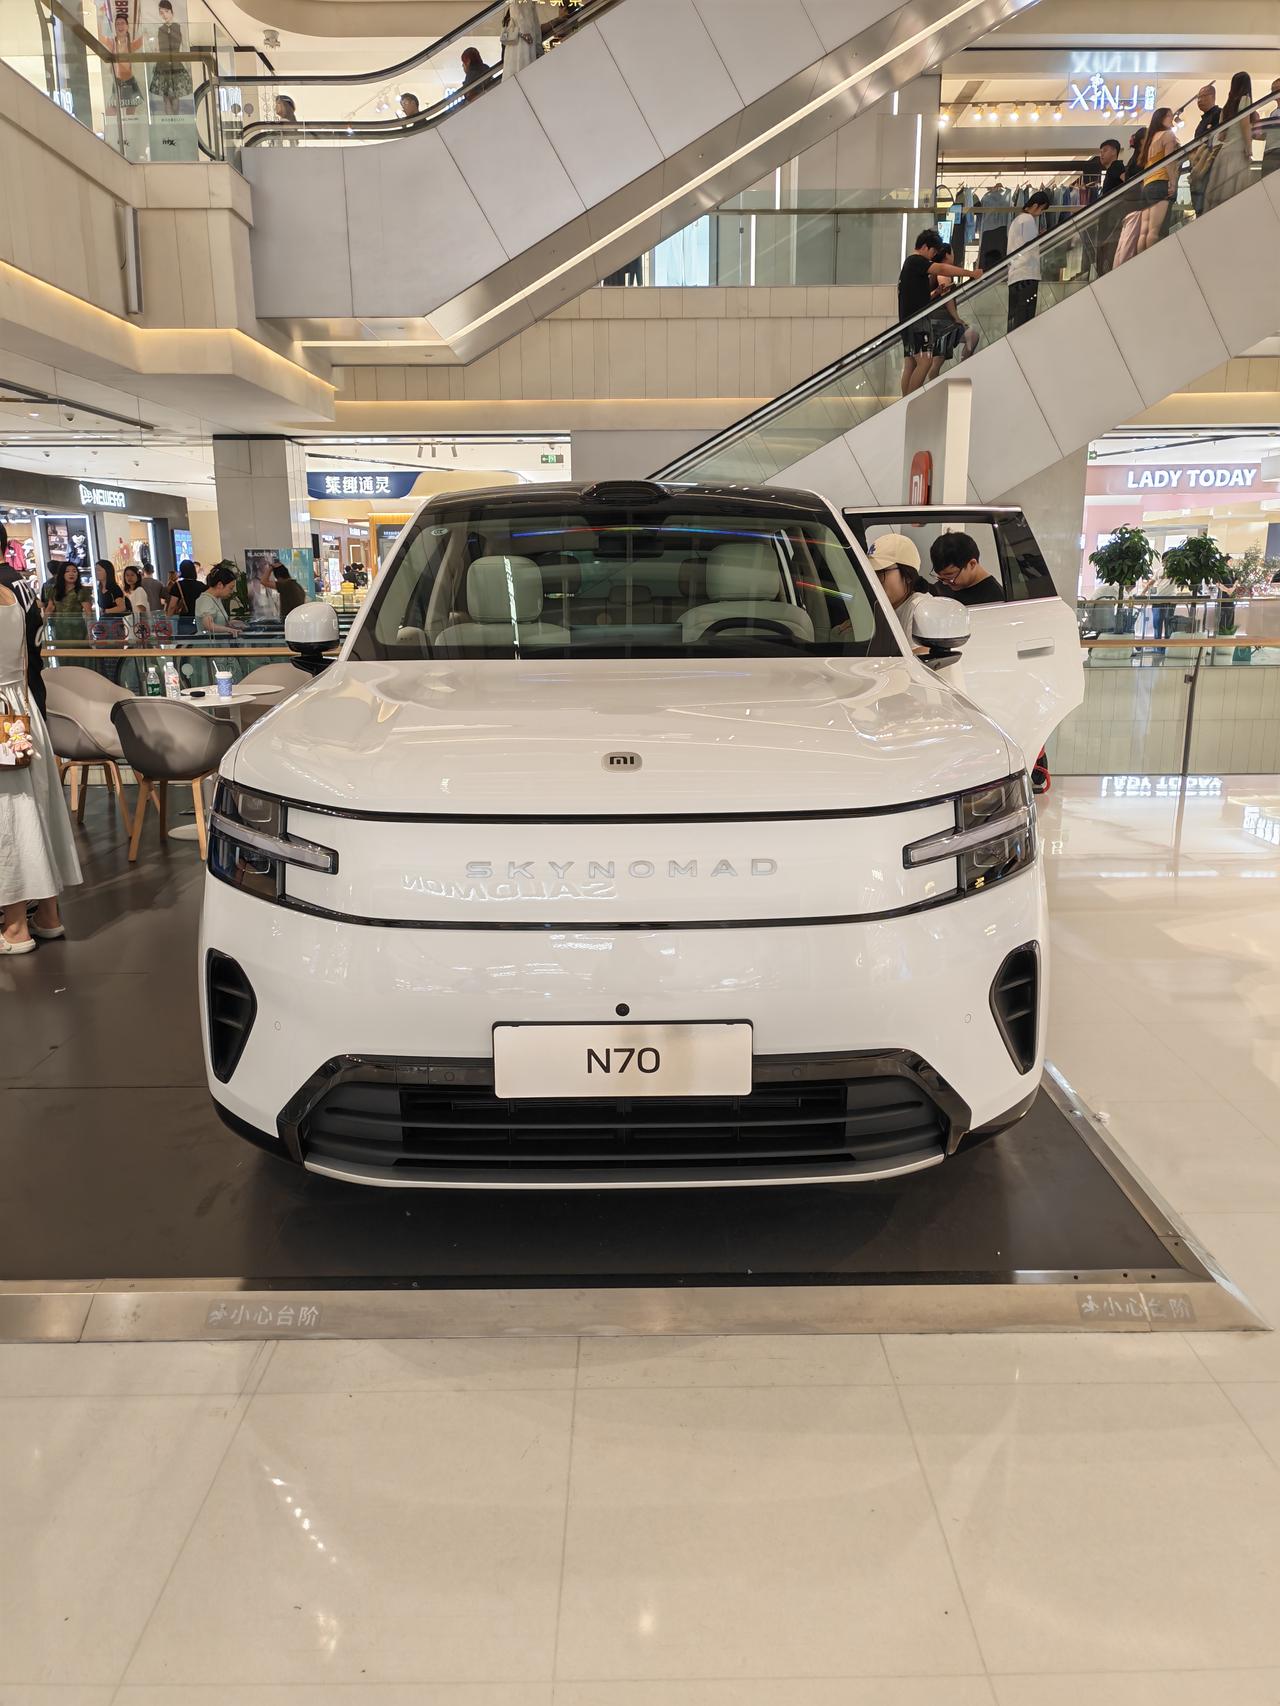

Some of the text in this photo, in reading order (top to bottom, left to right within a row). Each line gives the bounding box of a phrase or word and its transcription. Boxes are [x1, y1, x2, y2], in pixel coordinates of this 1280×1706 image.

[1127, 468, 1257, 488] LADY TODAY
[465, 858, 778, 879] SKYNOMAD
[587, 1047, 661, 1074] N70
[230, 1304, 319, 1327] 小心台阶
